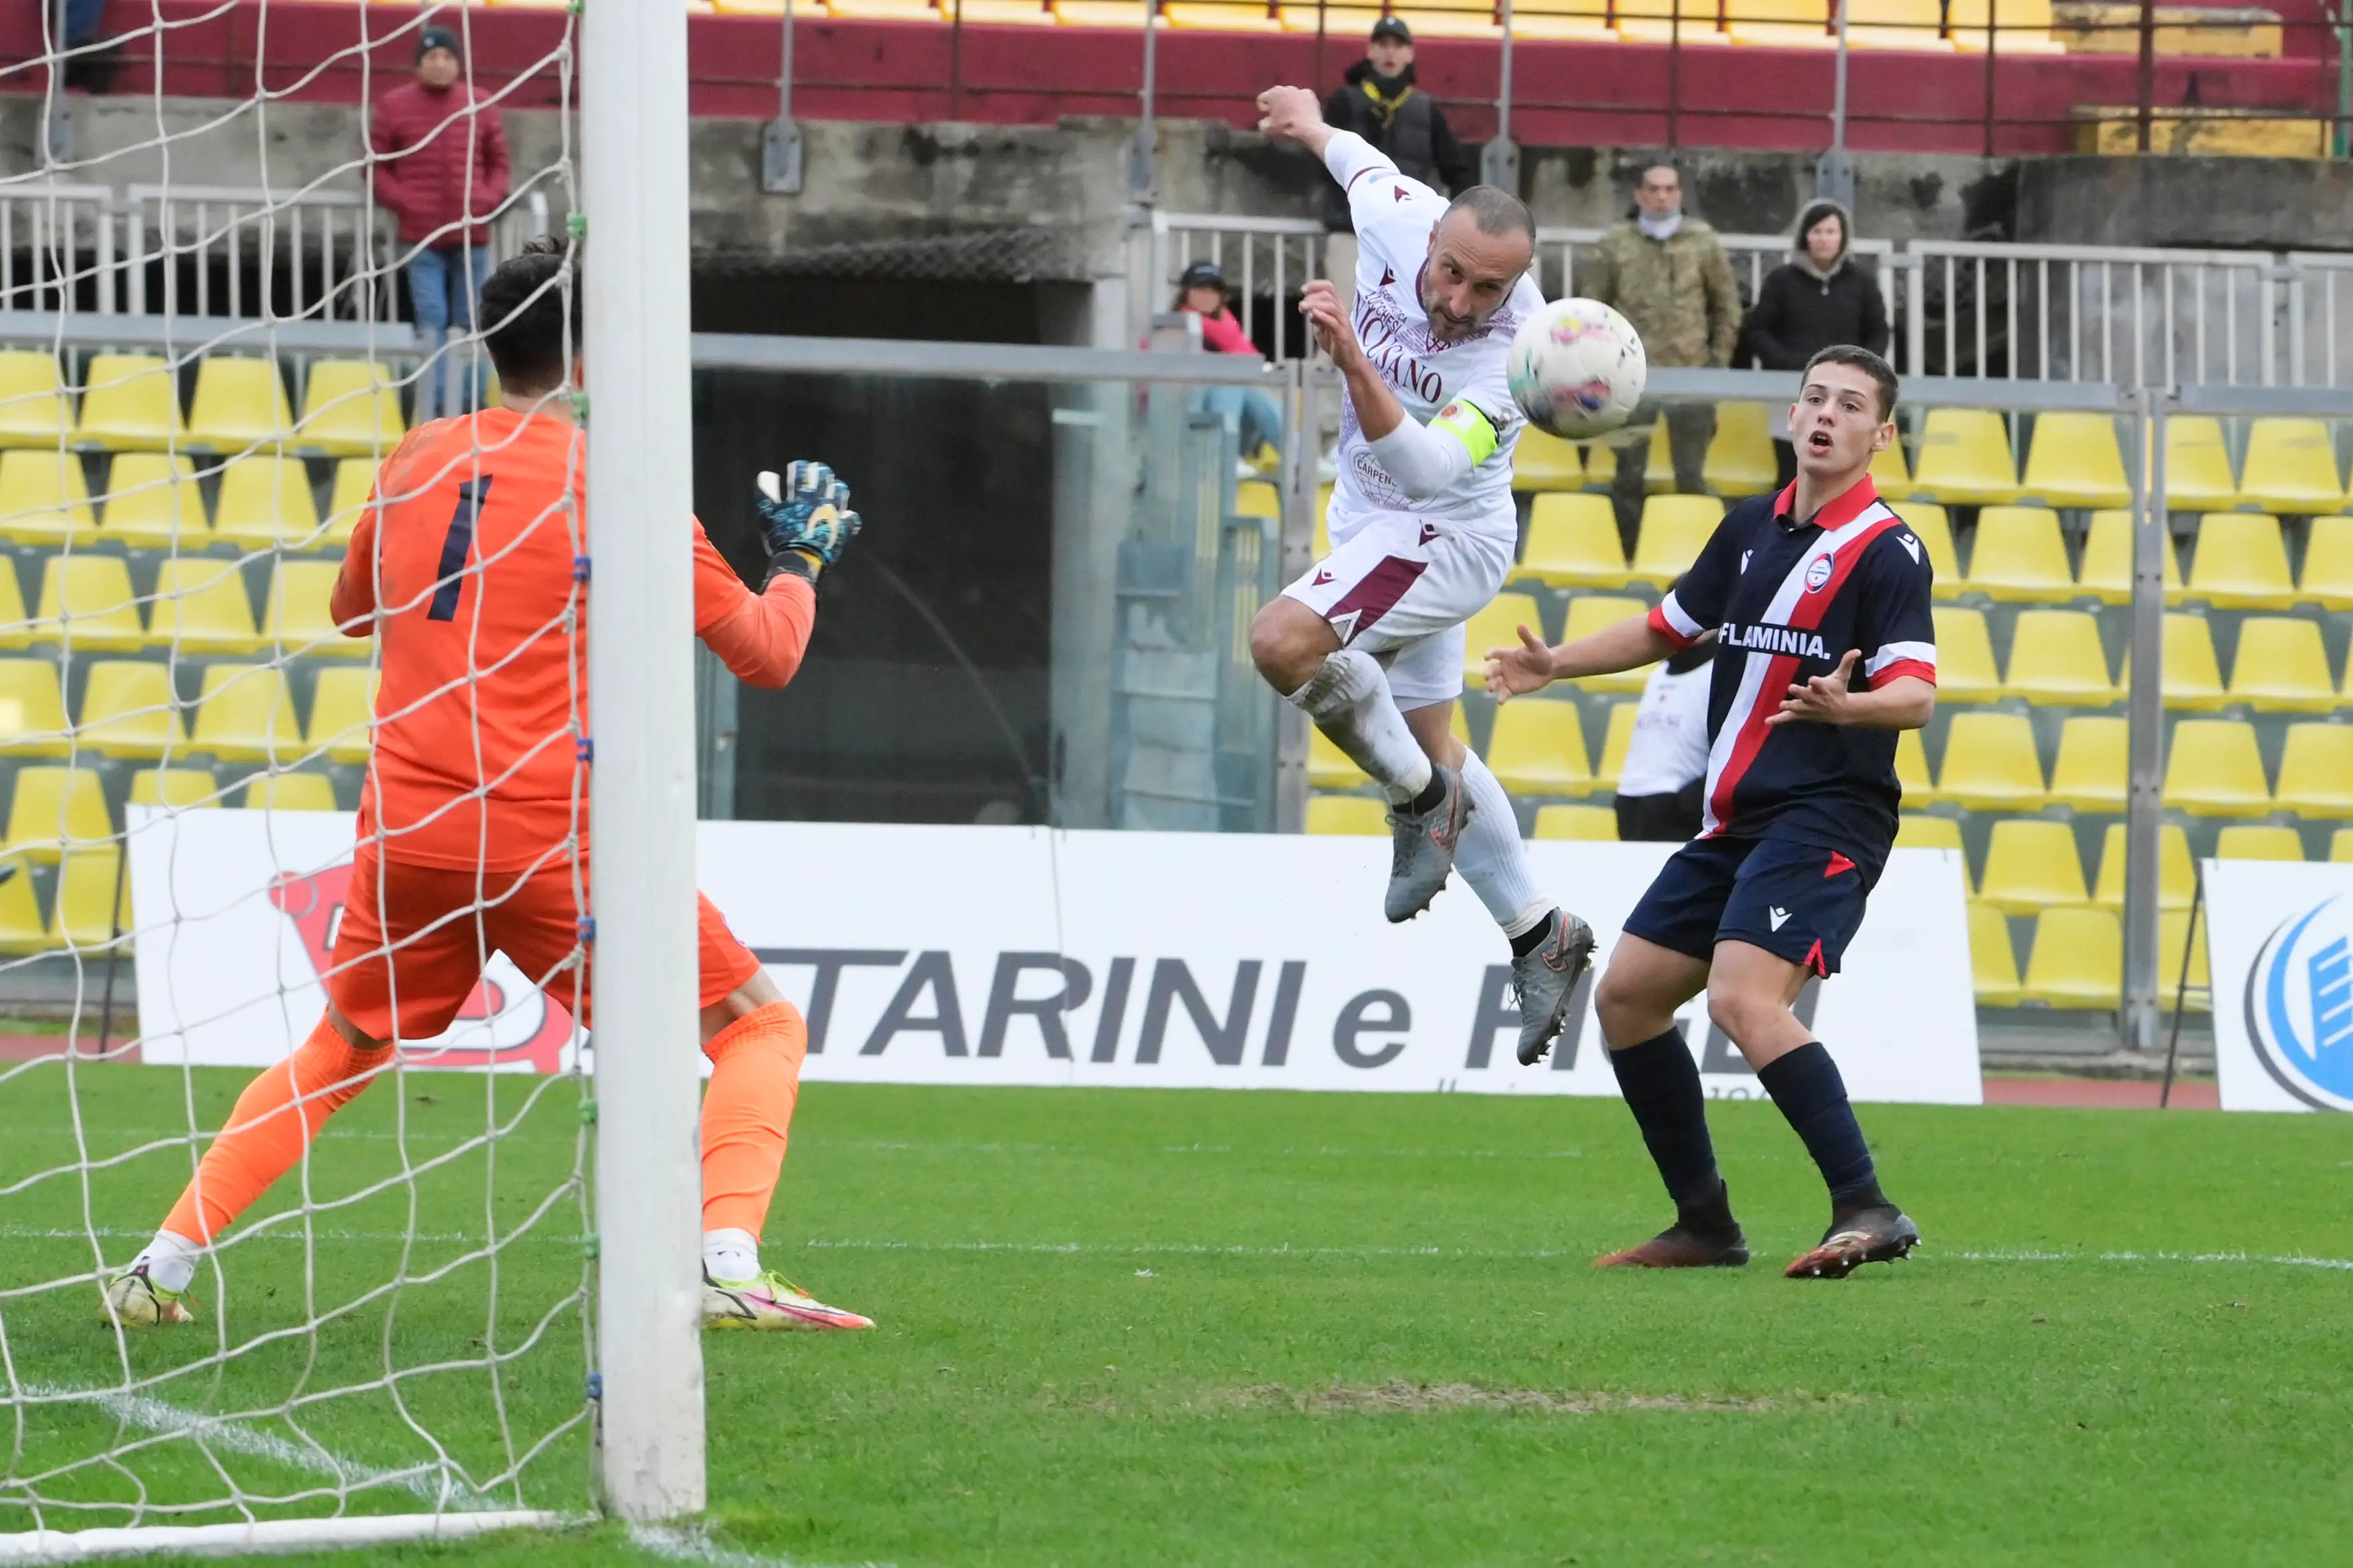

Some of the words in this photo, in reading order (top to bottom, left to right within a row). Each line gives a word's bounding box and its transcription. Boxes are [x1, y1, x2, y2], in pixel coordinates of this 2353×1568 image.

[1357, 459, 1398, 487] CARPEN
[427, 474, 493, 622] 1
[752, 947, 1307, 1067] TARINI
[1332, 989, 1412, 1068] e
